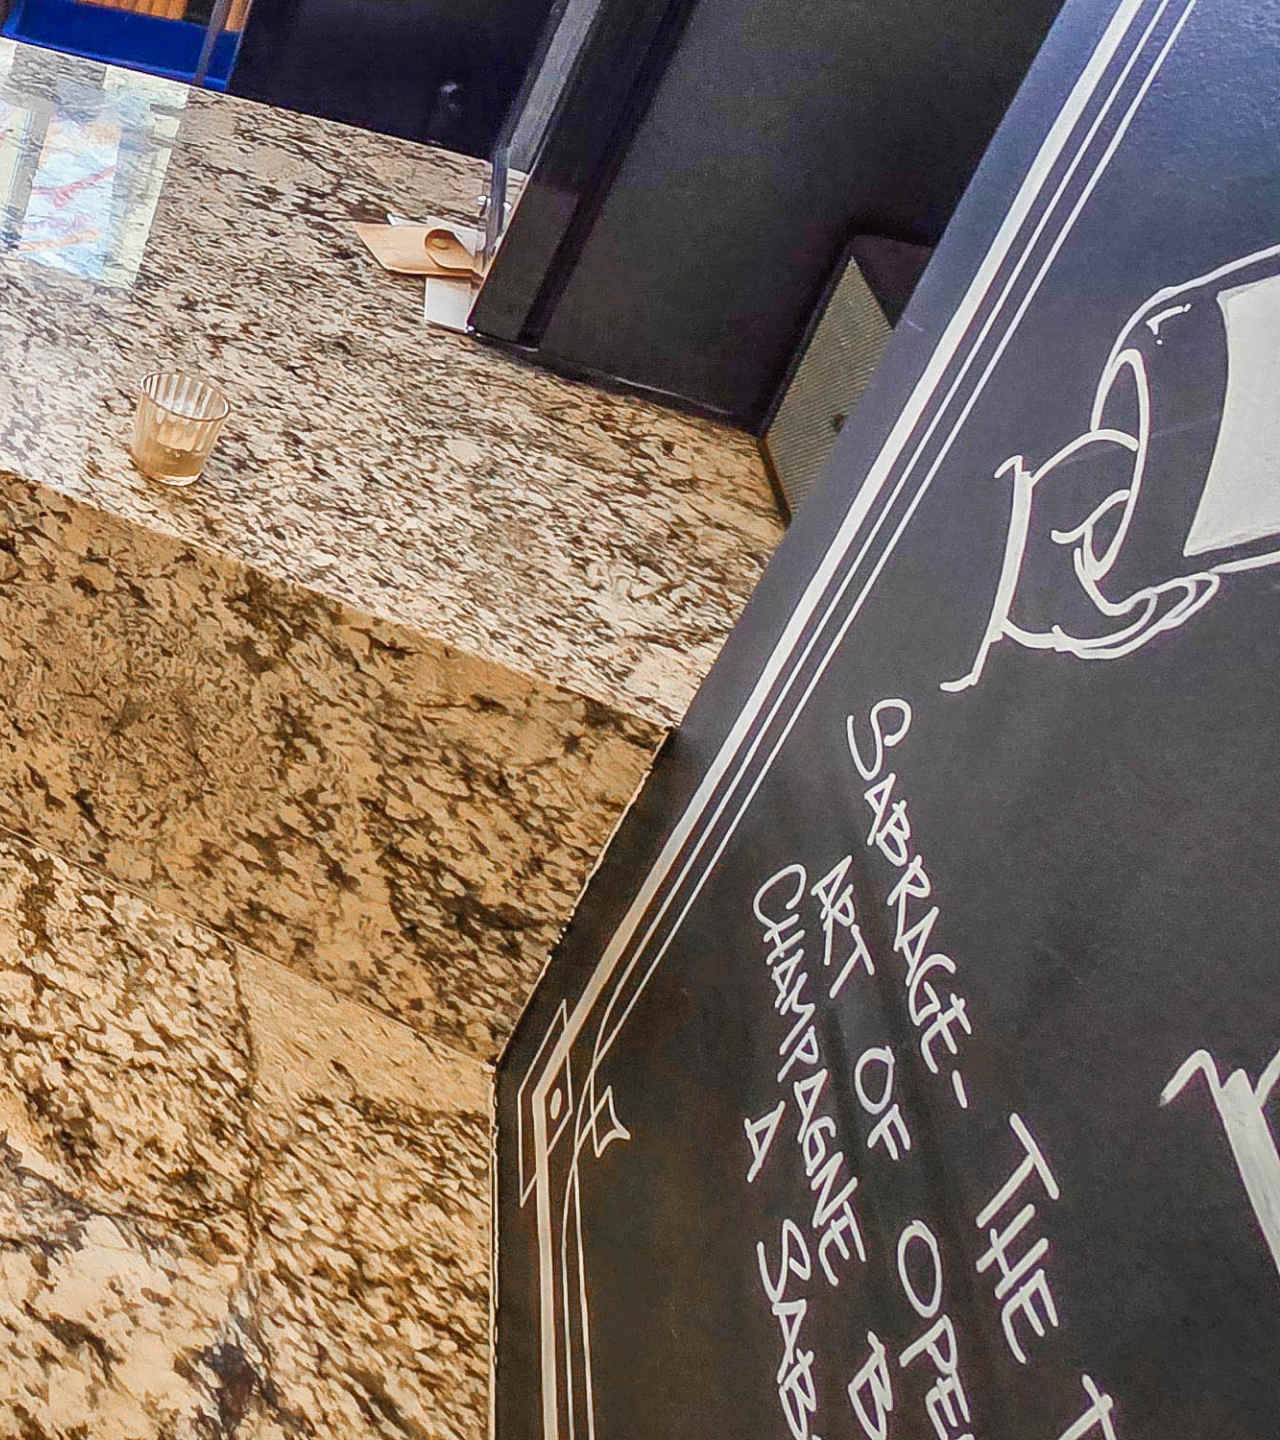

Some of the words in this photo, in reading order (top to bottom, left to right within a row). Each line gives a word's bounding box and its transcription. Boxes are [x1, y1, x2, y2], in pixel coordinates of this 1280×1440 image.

[743, 1100, 786, 1184] A
[753, 863, 867, 1287] CHAMPAGNE
[811, 855, 876, 1000] ART
[854, 1045, 912, 1160] OF
[975, 1112, 1060, 1364] THE
